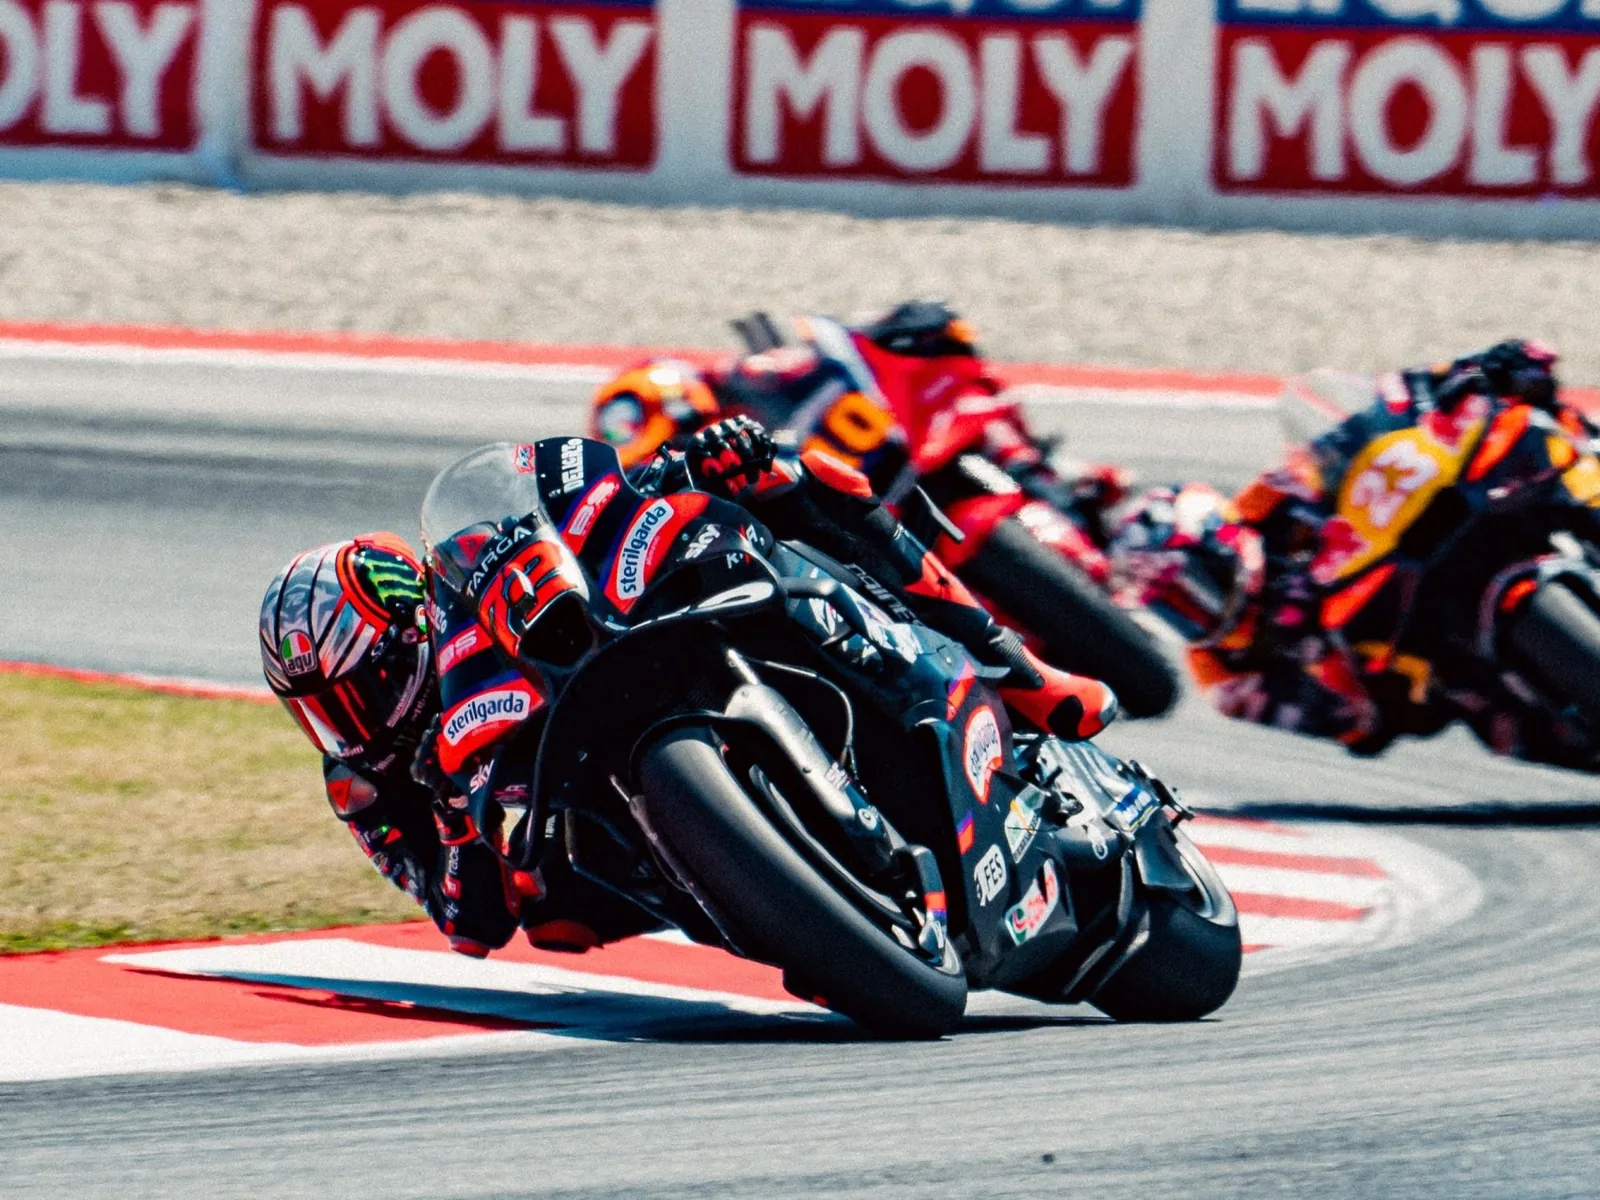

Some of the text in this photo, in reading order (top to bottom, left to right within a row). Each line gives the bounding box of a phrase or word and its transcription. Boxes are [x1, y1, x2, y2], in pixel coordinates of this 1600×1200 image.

[267, 7, 655, 152] MOLY
[746, 26, 1134, 174] MOLY
[1230, 37, 1600, 186] MOLY
[1349, 440, 1440, 527] 23
[465, 525, 532, 597] TARGA
[619, 505, 667, 594] sterilgarda
[287, 652, 312, 673] agv
[447, 692, 524, 740] sterilgarda
